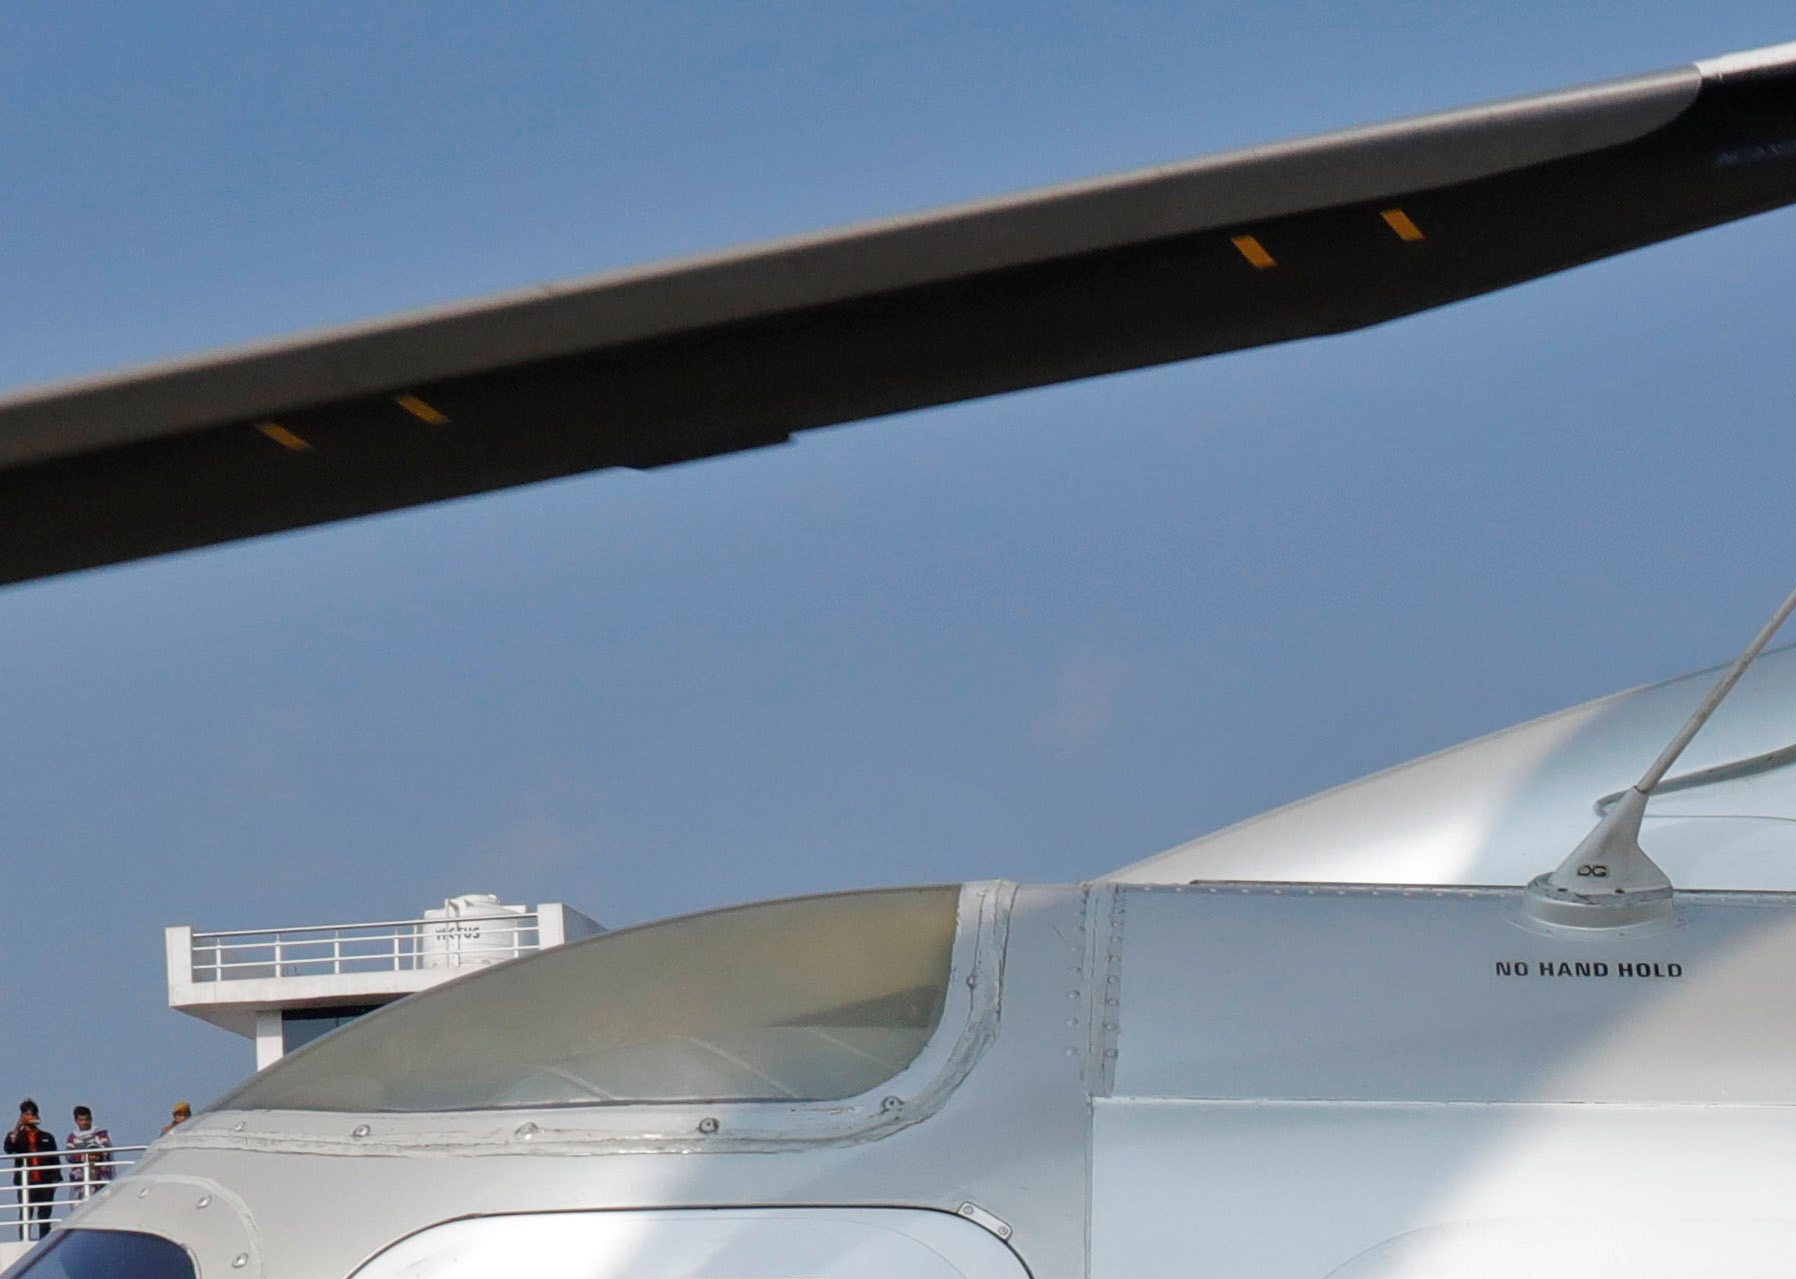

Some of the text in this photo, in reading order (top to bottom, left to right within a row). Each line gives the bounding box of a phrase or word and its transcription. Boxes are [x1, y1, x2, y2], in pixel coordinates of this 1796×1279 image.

[1495, 961, 1683, 978] NO HAND HOLD
